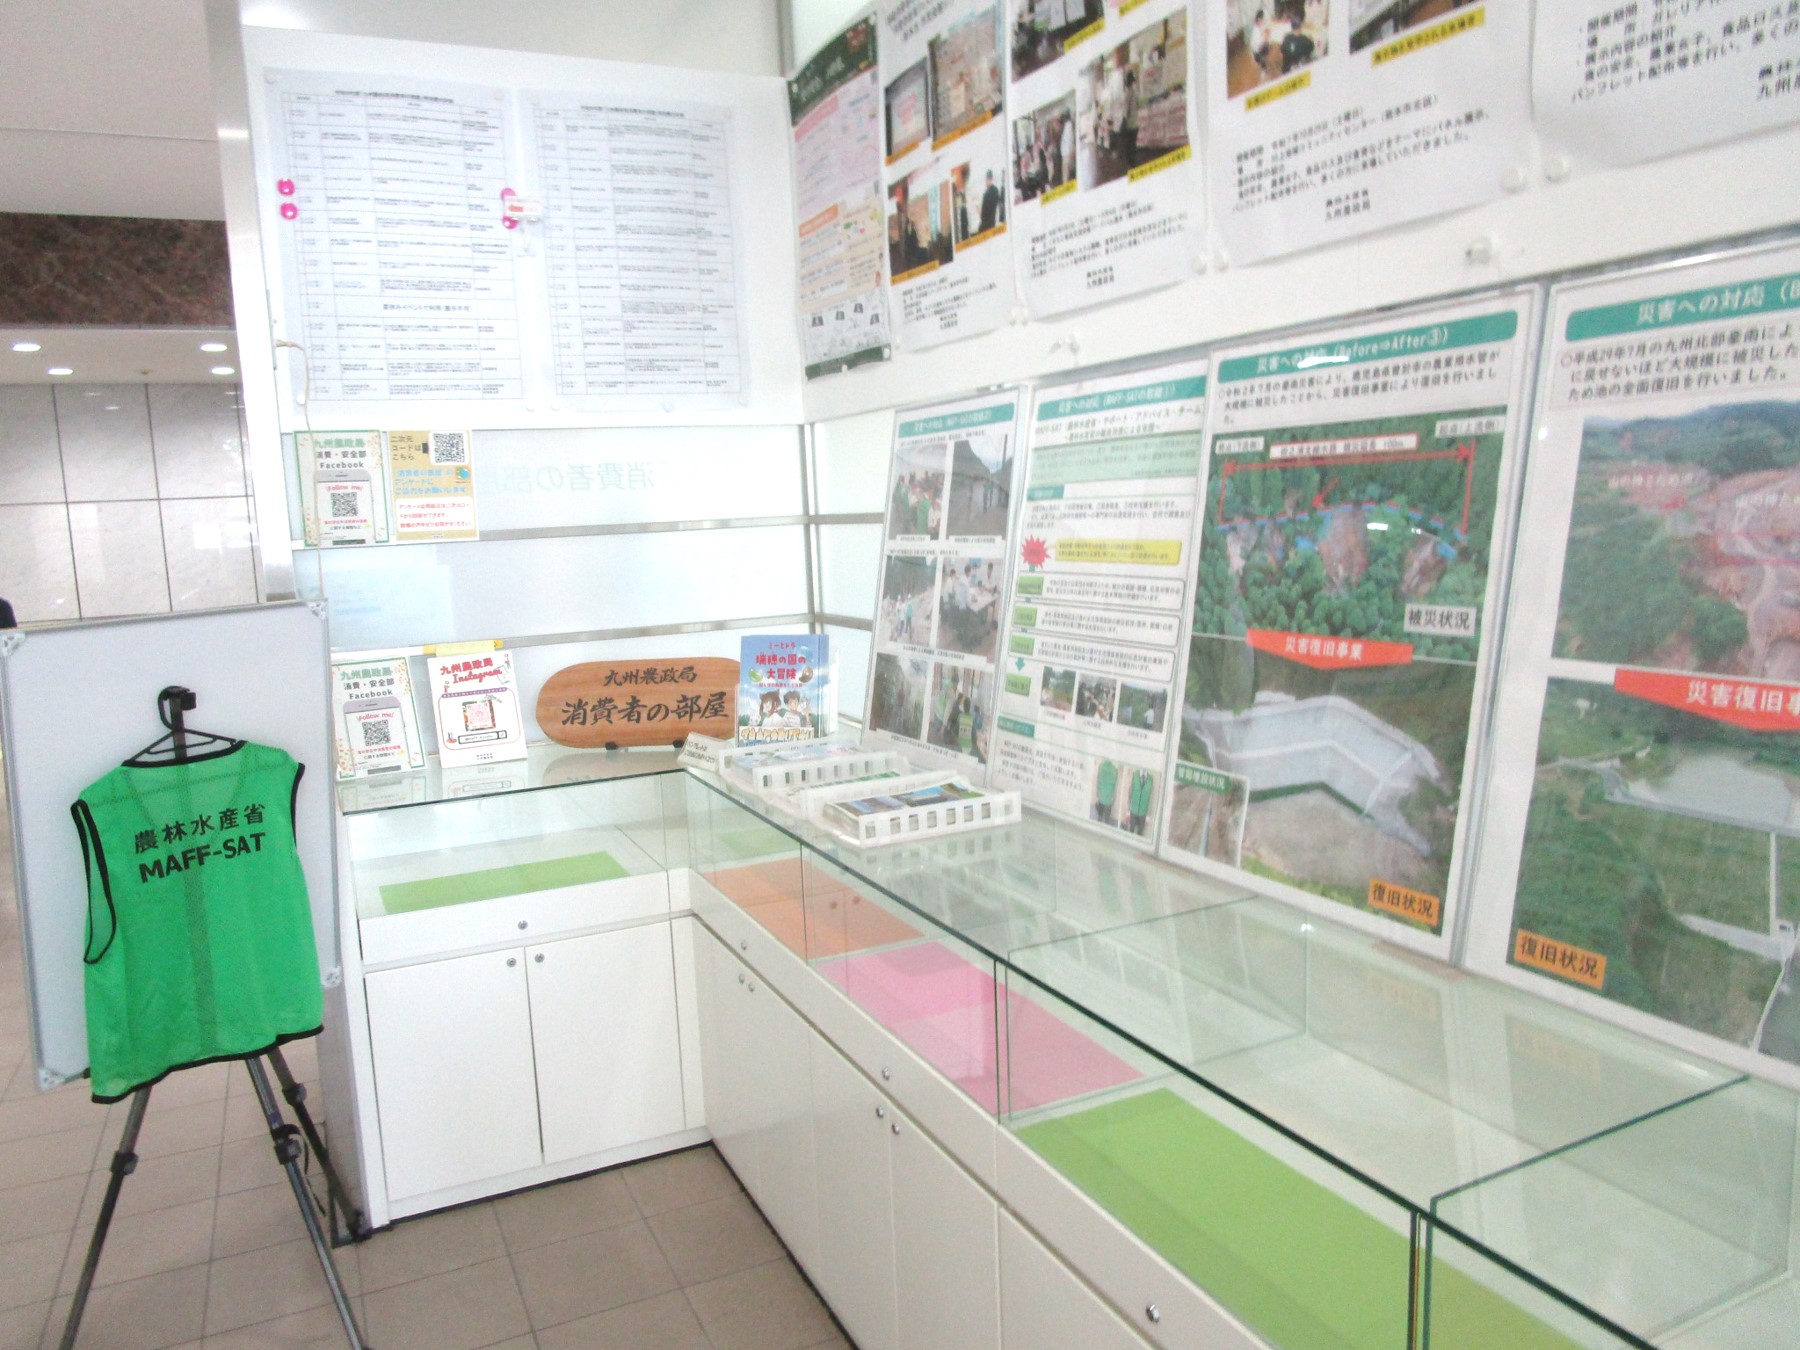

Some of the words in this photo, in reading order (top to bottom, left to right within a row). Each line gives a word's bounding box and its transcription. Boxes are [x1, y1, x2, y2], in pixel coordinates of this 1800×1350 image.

[320, 461, 364, 469] Facebook
[392, 453, 415, 461] こちら
[1408, 608, 1470, 631] 被災状況
[1285, 636, 1363, 660] 災害復旧事業
[440, 657, 494, 676] 九州農政局
[452, 668, 503, 684] Instagram
[603, 665, 698, 687] 九州農政局
[767, 667, 797, 679] 大冒険
[344, 678, 395, 690] 消費・安全部
[349, 689, 393, 700] Facebook
[561, 690, 730, 726] 消費者の部屋
[135, 803, 266, 855] 農林水産省
[139, 832, 266, 883] MAFF-SAT
[1373, 882, 1433, 918] 復旧状況
[1520, 935, 1598, 979] 復旧状況
